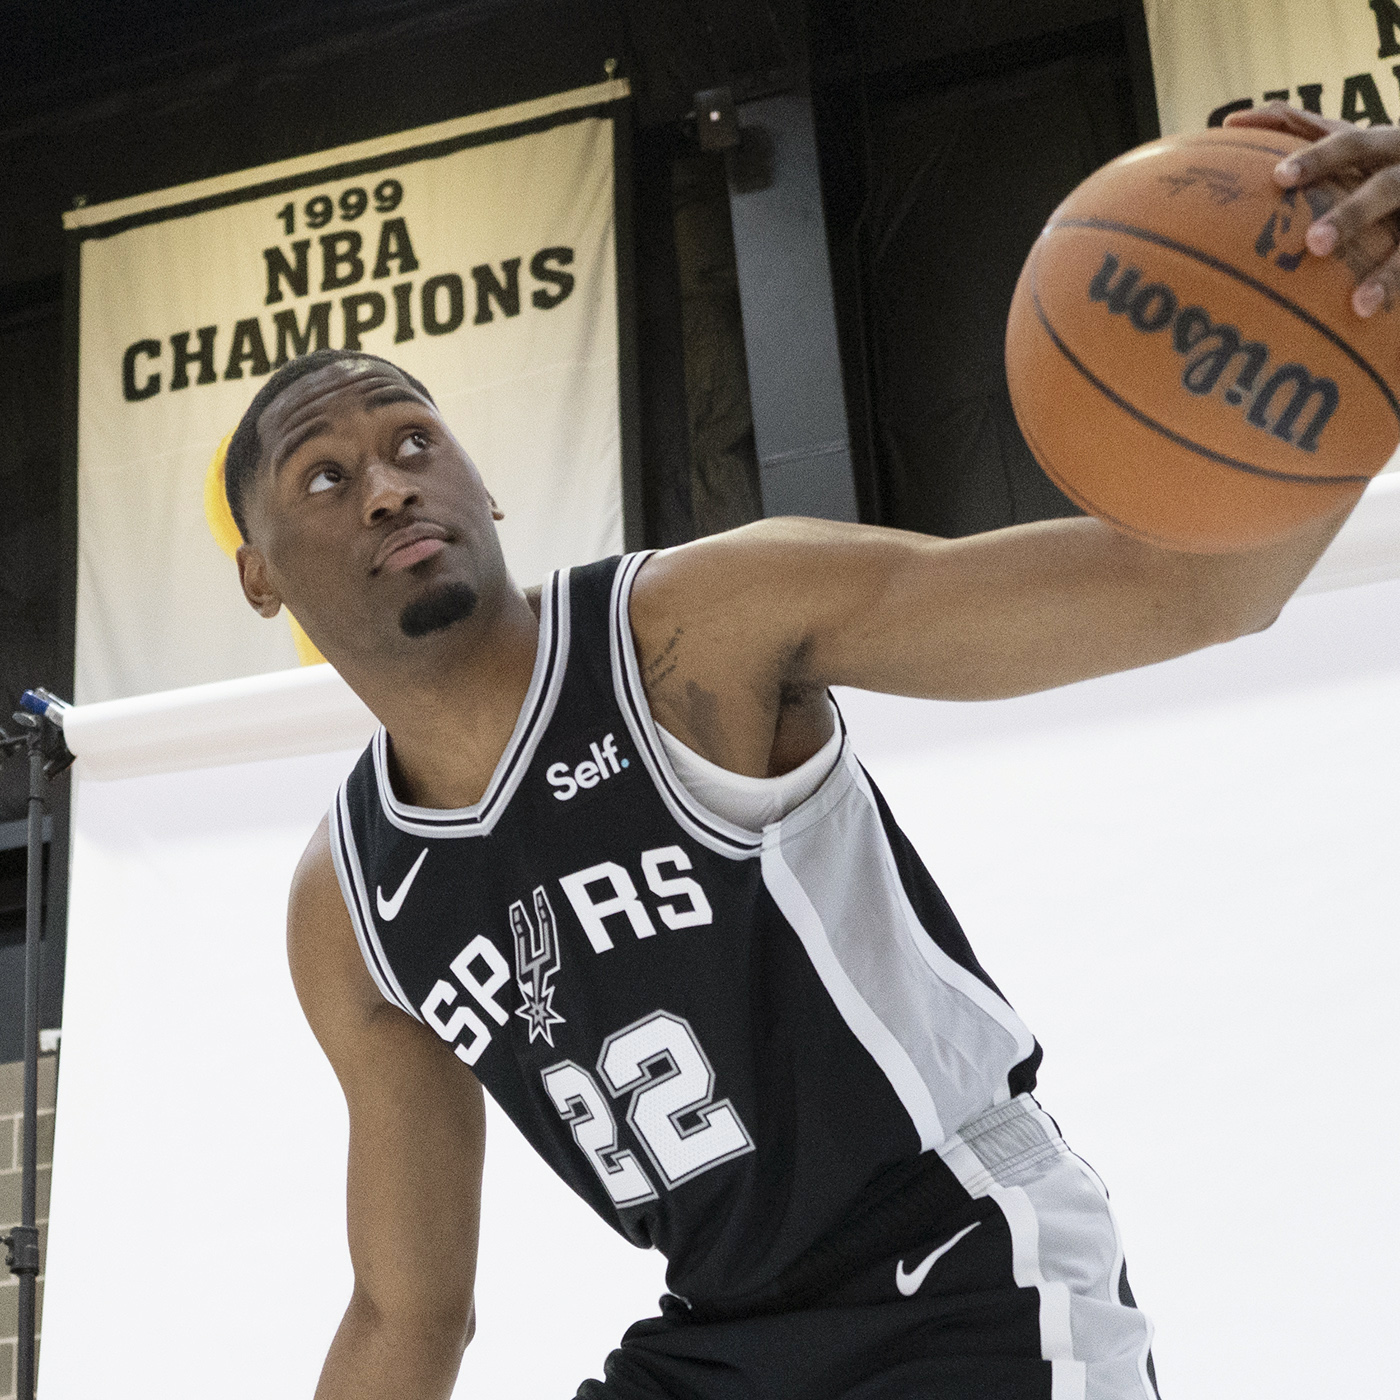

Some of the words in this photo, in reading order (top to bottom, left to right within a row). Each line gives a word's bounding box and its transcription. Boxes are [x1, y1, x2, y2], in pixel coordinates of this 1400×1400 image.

[262, 216, 419, 305] NBA
[276, 178, 403, 235] 1999
[122, 246, 576, 401] CHAMPIONS
[1087, 252, 1340, 455] Wilson
[546, 733, 630, 801] Self.
[540, 1009, 756, 1210] 22
